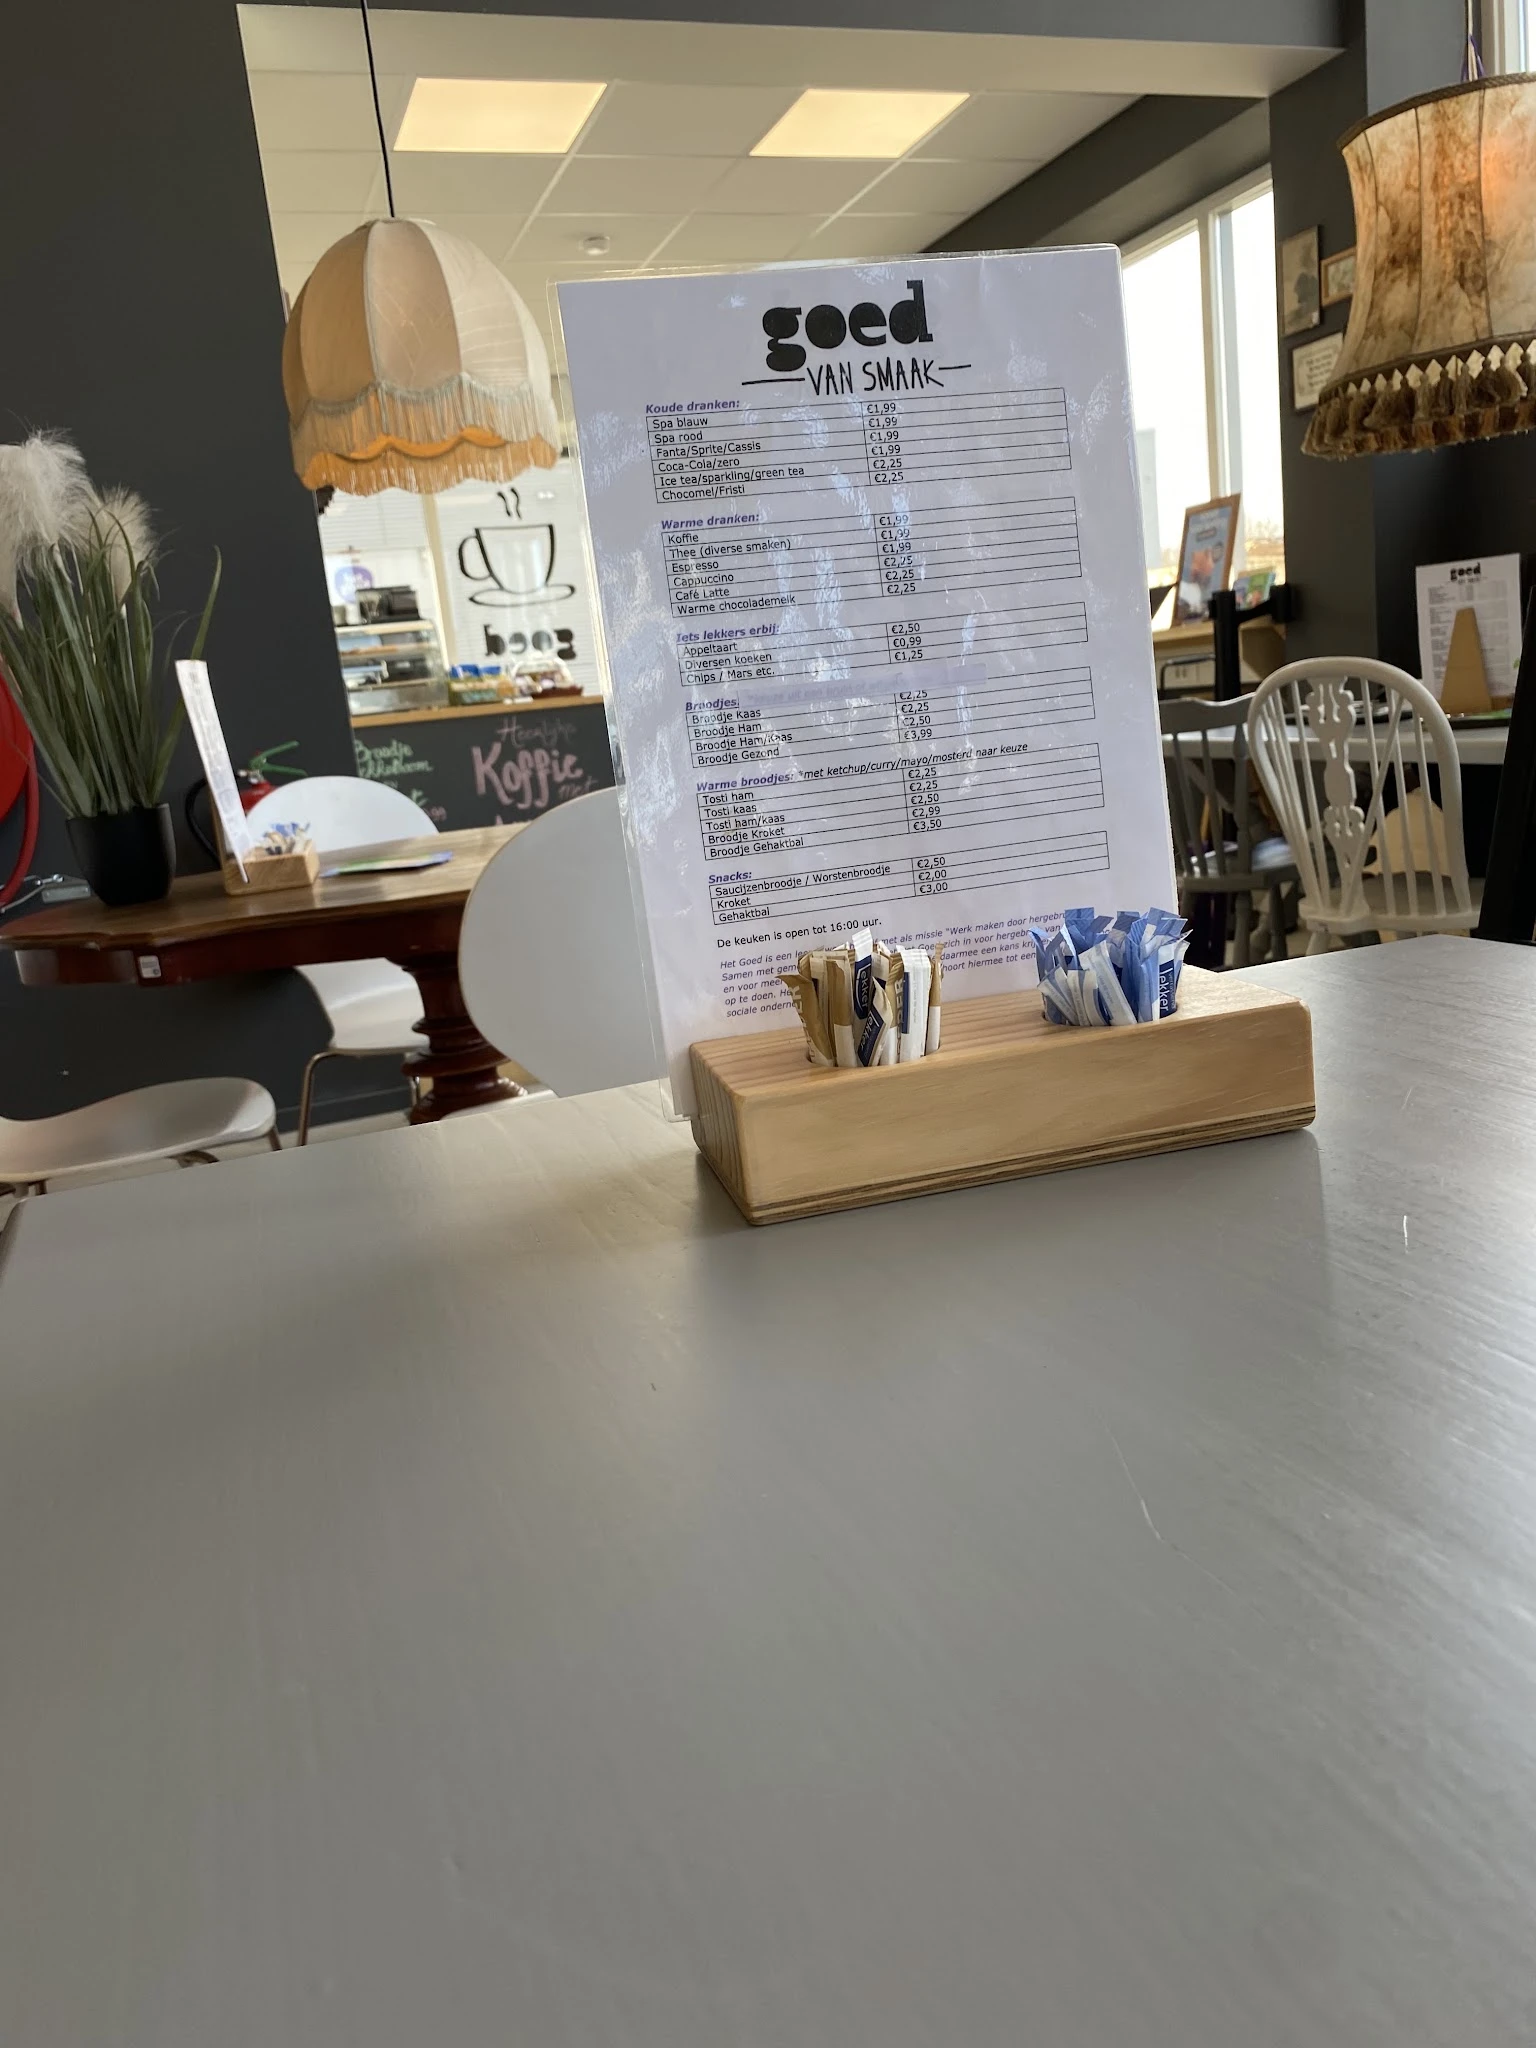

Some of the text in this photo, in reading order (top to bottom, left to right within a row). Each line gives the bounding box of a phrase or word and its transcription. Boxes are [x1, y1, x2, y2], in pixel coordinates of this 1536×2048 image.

[762, 279, 933, 371] goed
[807, 357, 944, 395] VAN SMAAK
[645, 400, 740, 414] Koude dranken:
[652, 403, 896, 431] Spa blauw €1,99
[654, 417, 898, 445] Spa rood €1,99
[656, 431, 899, 458] Fanta/Sprite/Cassis €1,99
[658, 444, 900, 472] Coca-Cola/zero €1,99
[660, 458, 902, 486] Ice tea/sparkling/green tea €2,25
[662, 472, 904, 500] Chocomel/Fristi €2,25
[662, 514, 760, 530] Warme dranken:
[668, 515, 909, 544] Koffie €1,99
[670, 528, 910, 558] Thee (diverse smaken) €1,99
[672, 542, 911, 573] Espresso €1,99
[674, 555, 913, 588] Cappuccino €2,25
[676, 569, 914, 601] Café Latte €2,25
[1450, 562, 1481, 582] goed
[678, 582, 916, 614] Warme chocolademelk €2,25
[676, 624, 780, 642] Iets lekkers erbij:
[684, 622, 920, 656] Appeltaart €2,50
[686, 636, 922, 670] Diversen koeken €0,99
[687, 673, 716, 684] Chips
[728, 670, 752, 679] Mars
[756, 666, 775, 676] etc.
[894, 650, 924, 661] €1,25
[692, 712, 732, 724] Broodje
[736, 709, 762, 718] Kaas
[694, 702, 930, 738] Broodje Ham €2,25
[696, 740, 736, 752] Broodje
[698, 728, 932, 765] Broodje Gezond €3,99
[471, 741, 583, 809] Koffie
[696, 782, 737, 792] Warme
[741, 773, 794, 786] broodjes:
[827, 750, 972, 776] ketchup/curry/mayo/mosterd
[975, 746, 998, 756] naar
[1000, 742, 1028, 754] keuze
[703, 767, 937, 804] Tosti ham €2,25
[704, 780, 938, 818] Tosti kaas €2,25
[706, 793, 940, 830] Tosti ham/kaas €2,50
[708, 806, 940, 844] Broodje Kroket €2,99
[710, 818, 942, 858] Broodje Gehaktbal €3,50
[708, 871, 752, 884] Snacks:
[716, 878, 802, 896] Saucijzenbroodje
[813, 865, 890, 882] Worstenbroodje
[917, 856, 946, 868] €2,50
[717, 870, 947, 909] Kroket €2,00
[719, 882, 948, 922] Gehaktbal €3,00
[717, 917, 882, 948] De keuken is open tot 16:00 uur.
[720, 960, 736, 969] Het
[739, 956, 762, 966] Goed
[766, 954, 772, 962] is
[776, 952, 792, 960] een
[900, 934, 912, 942] als
[916, 930, 943, 940] missie
[976, 920, 1004, 932] maken
[1007, 918, 1026, 926] door
[722, 972, 753, 981] Samen
[756, 968, 774, 976] met
[963, 936, 971, 944] in
[974, 934, 992, 943] voor
[724, 986, 734, 994] en
[738, 982, 758, 992] voor
[981, 946, 996, 954] een
[1000, 943, 1020, 952] kans
[725, 998, 736, 1006] op
[740, 994, 748, 1003] te
[752, 992, 776, 1002] doen.
[968, 958, 1003, 969] hiermee
[1006, 954, 1020, 963] tot
[726, 1006, 758, 1017] sociale
